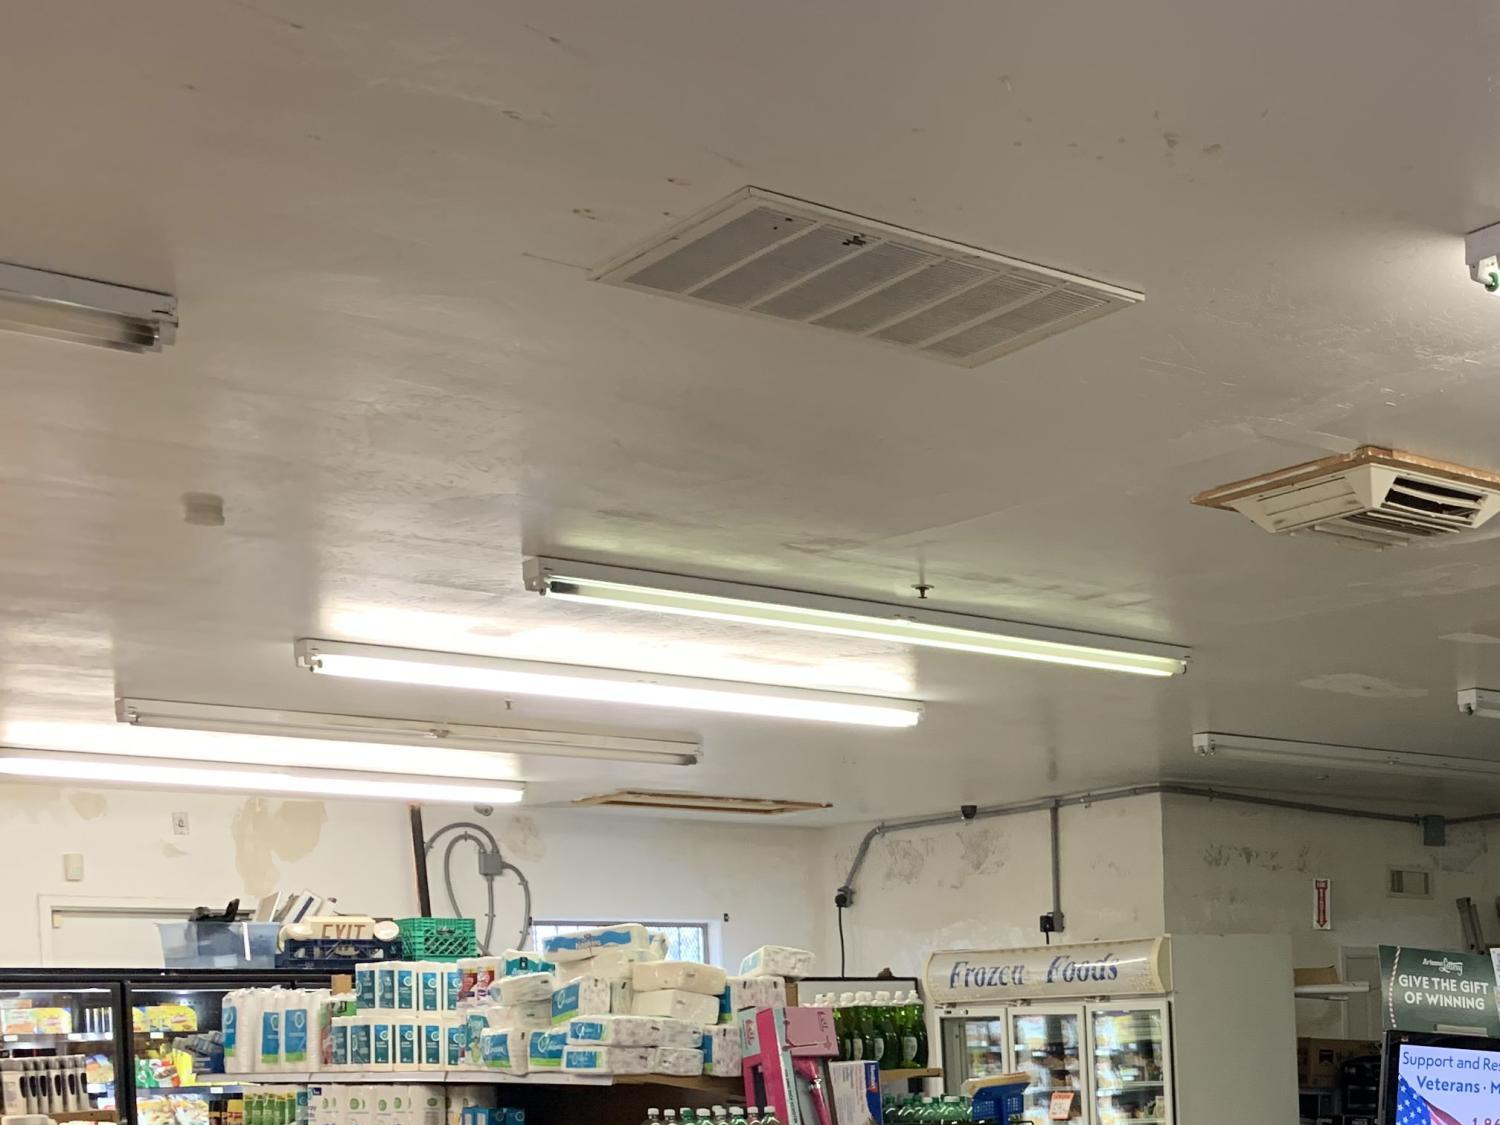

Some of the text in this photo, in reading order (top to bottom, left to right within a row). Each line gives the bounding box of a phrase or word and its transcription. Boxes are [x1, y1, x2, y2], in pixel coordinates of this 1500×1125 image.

[949, 952, 1120, 990] Frozen Foods
[1398, 974, 1489, 995] GIVE THE GIFT
[1404, 990, 1485, 1010] OF WINNING
[1402, 1051, 1454, 1070] Support
[1456, 1057, 1480, 1070] and
[1417, 1075, 1480, 1094] Veterans
